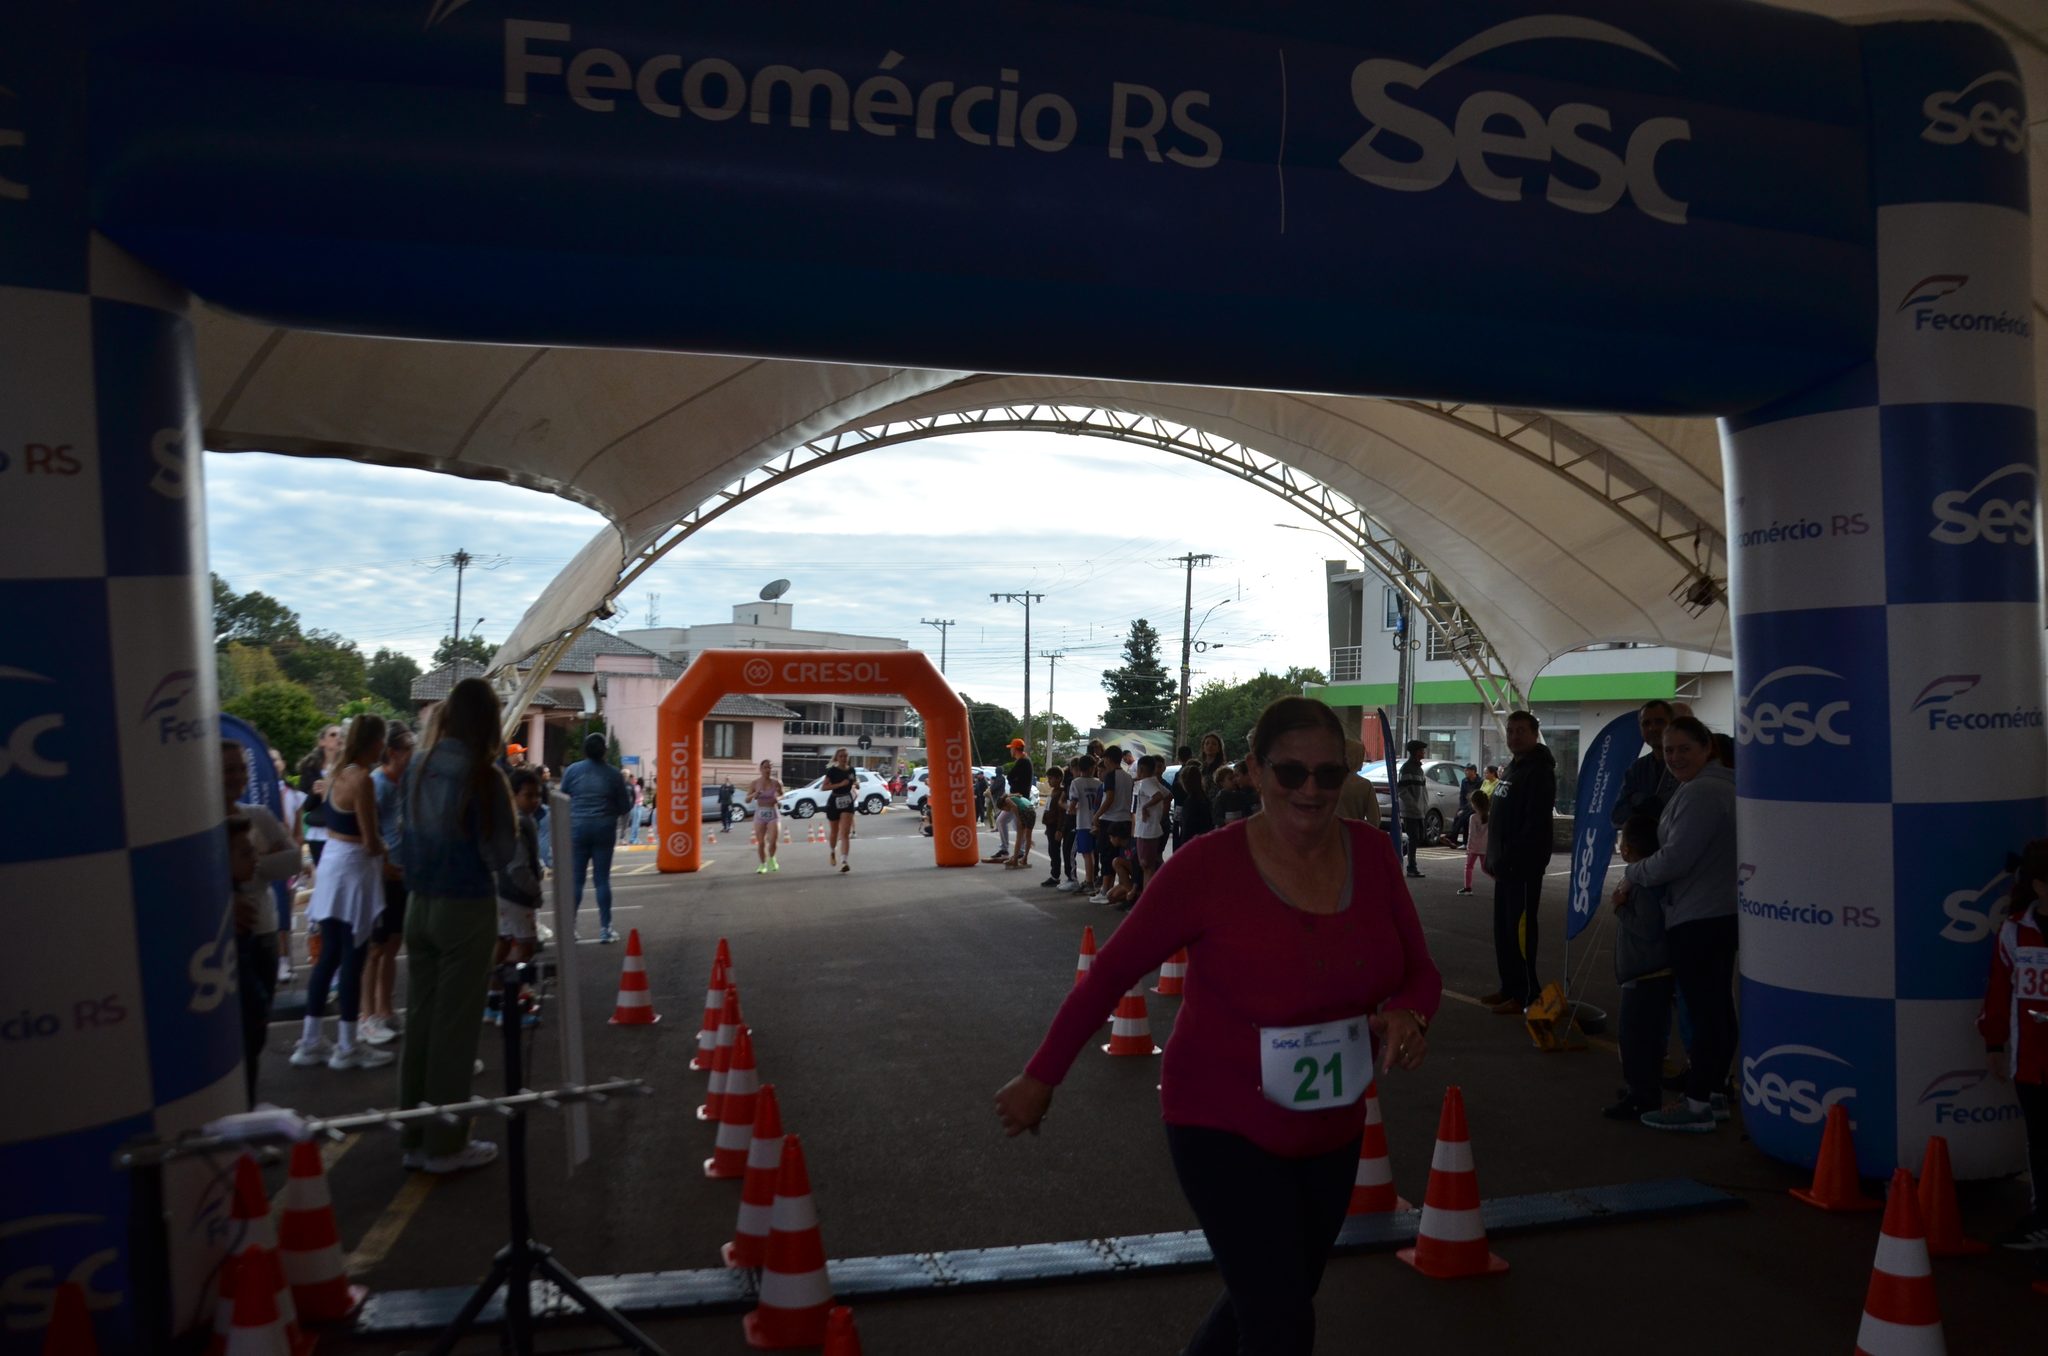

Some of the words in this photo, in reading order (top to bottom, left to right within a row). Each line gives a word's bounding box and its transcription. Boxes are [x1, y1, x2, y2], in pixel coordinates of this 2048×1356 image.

[504, 17, 1078, 153] Fecomércio
[1107, 81, 1223, 169] RS
[1338, 50, 1692, 225] Sesc
[24, 444, 82, 475] RS
[1831, 512, 1870, 537] RS
[781, 661, 889, 683] CRESOL
[671, 735, 689, 825] CRESOL
[945, 730, 968, 819] CRESOL
[1842, 905, 1881, 929] RS
[74, 993, 128, 1031] RS
[1294, 1051, 1343, 1103] 21
